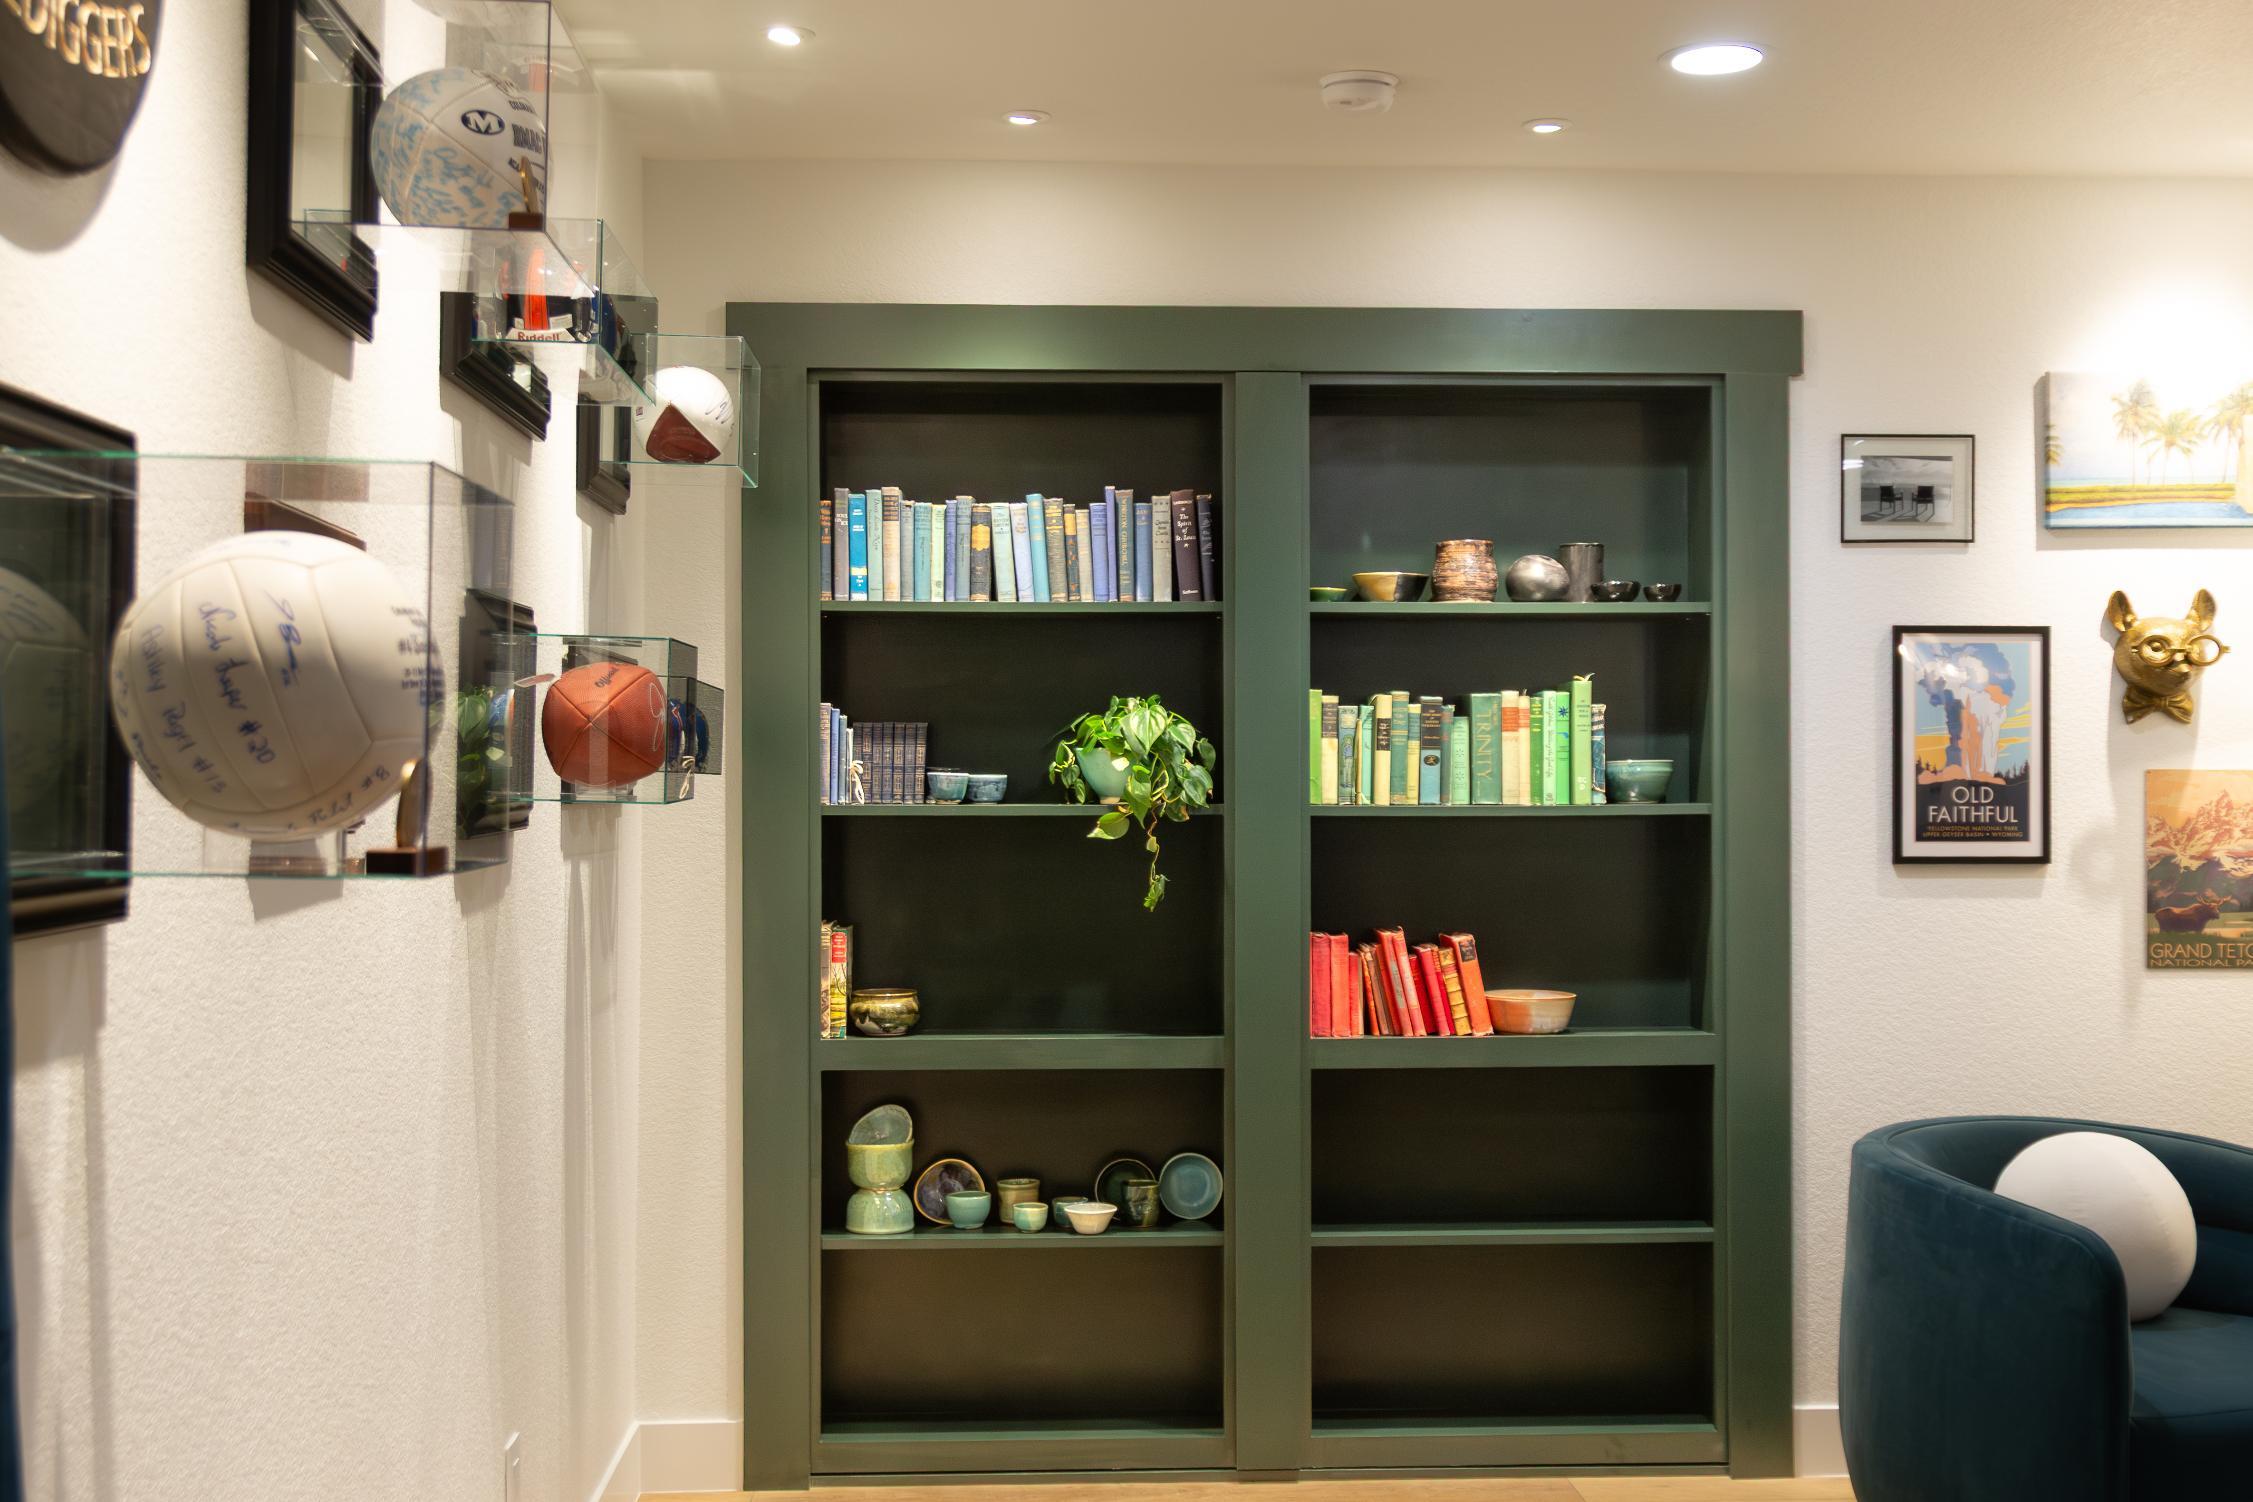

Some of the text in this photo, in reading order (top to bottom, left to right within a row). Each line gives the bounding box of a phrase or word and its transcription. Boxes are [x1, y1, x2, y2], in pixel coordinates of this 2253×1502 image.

[1952, 786, 1994, 803] OLD
[1928, 806, 2018, 822] FAITHFUL
[2151, 943, 2212, 958] GRAND
[2151, 959, 2232, 967] NATIONAL
